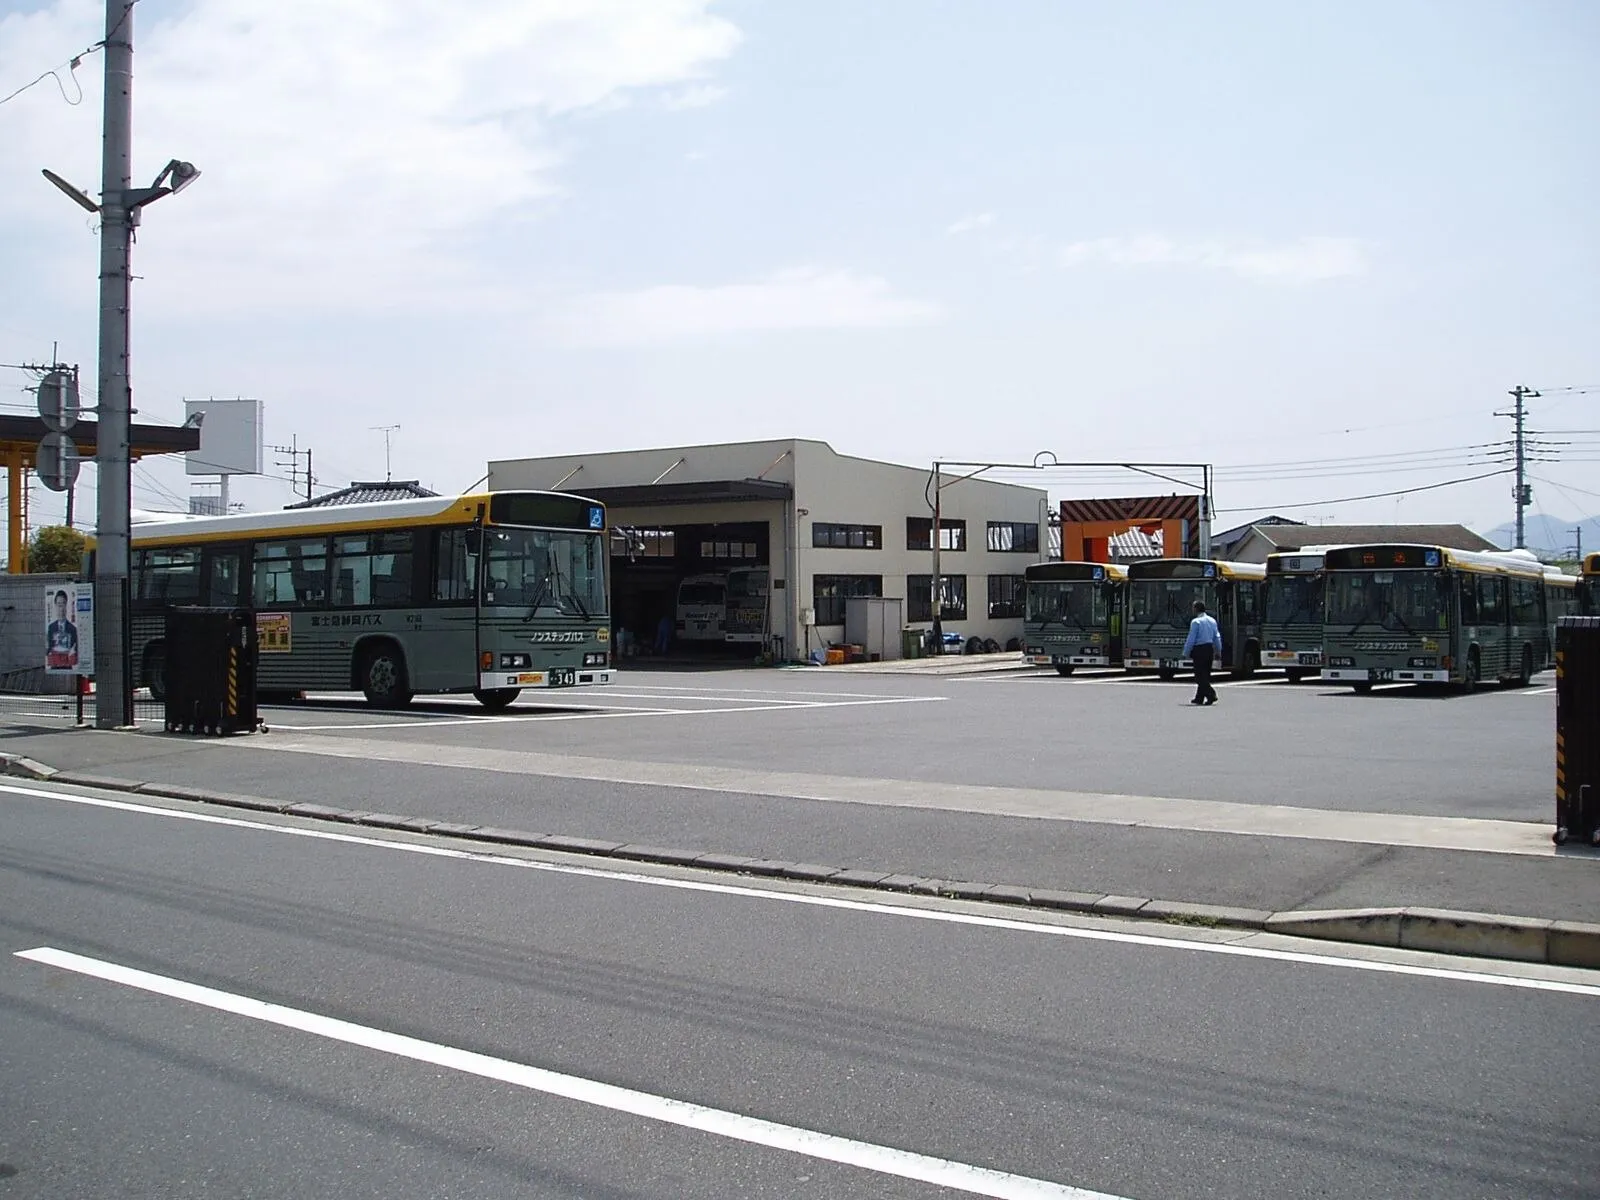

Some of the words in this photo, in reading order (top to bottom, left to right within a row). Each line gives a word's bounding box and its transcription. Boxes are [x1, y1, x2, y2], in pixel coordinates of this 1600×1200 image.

[532, 631, 585, 643] ノンステップバス
[1353, 641, 1408, 650] ノンステップバス
[558, 673, 573, 685] 343
